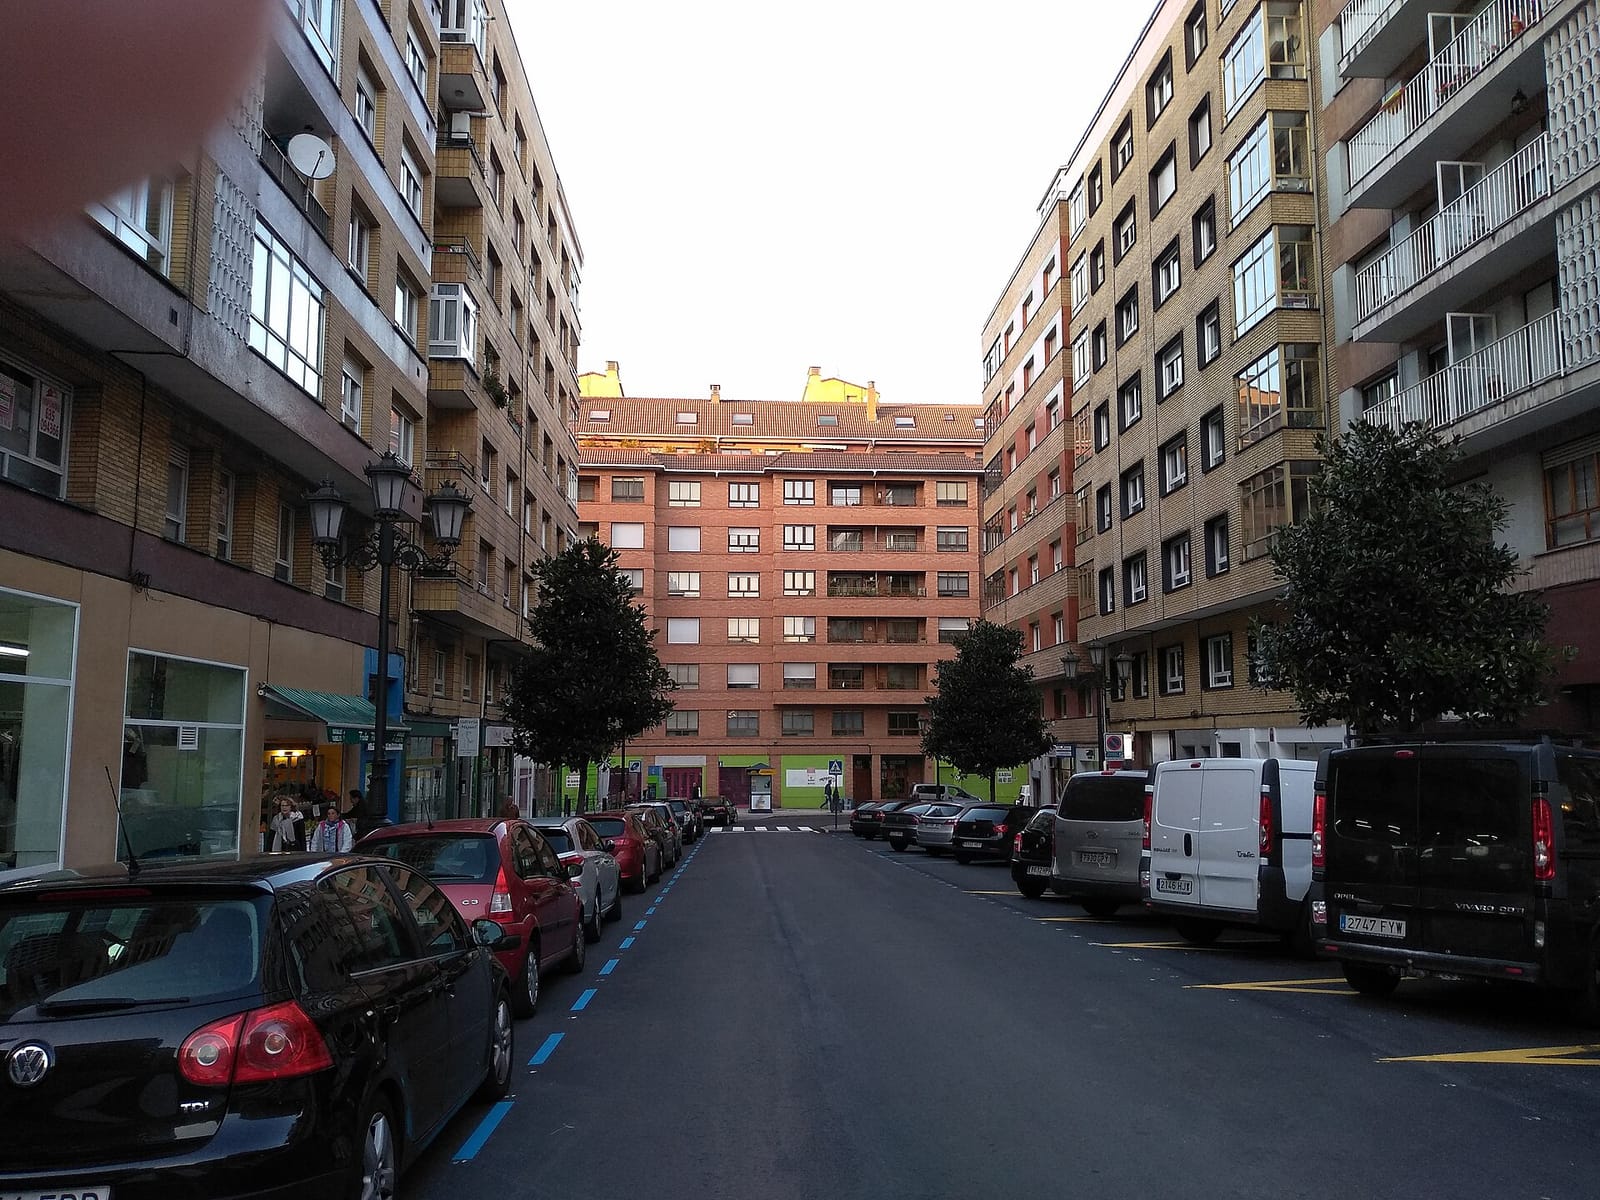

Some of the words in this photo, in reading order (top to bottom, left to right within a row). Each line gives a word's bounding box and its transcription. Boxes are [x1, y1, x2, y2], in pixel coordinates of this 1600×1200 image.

[1333, 892, 1355, 900] OPEL
[1455, 902, 1495, 913] VIVARO
[1347, 917, 1377, 932] 2747
[1380, 920, 1404, 935] FYW
